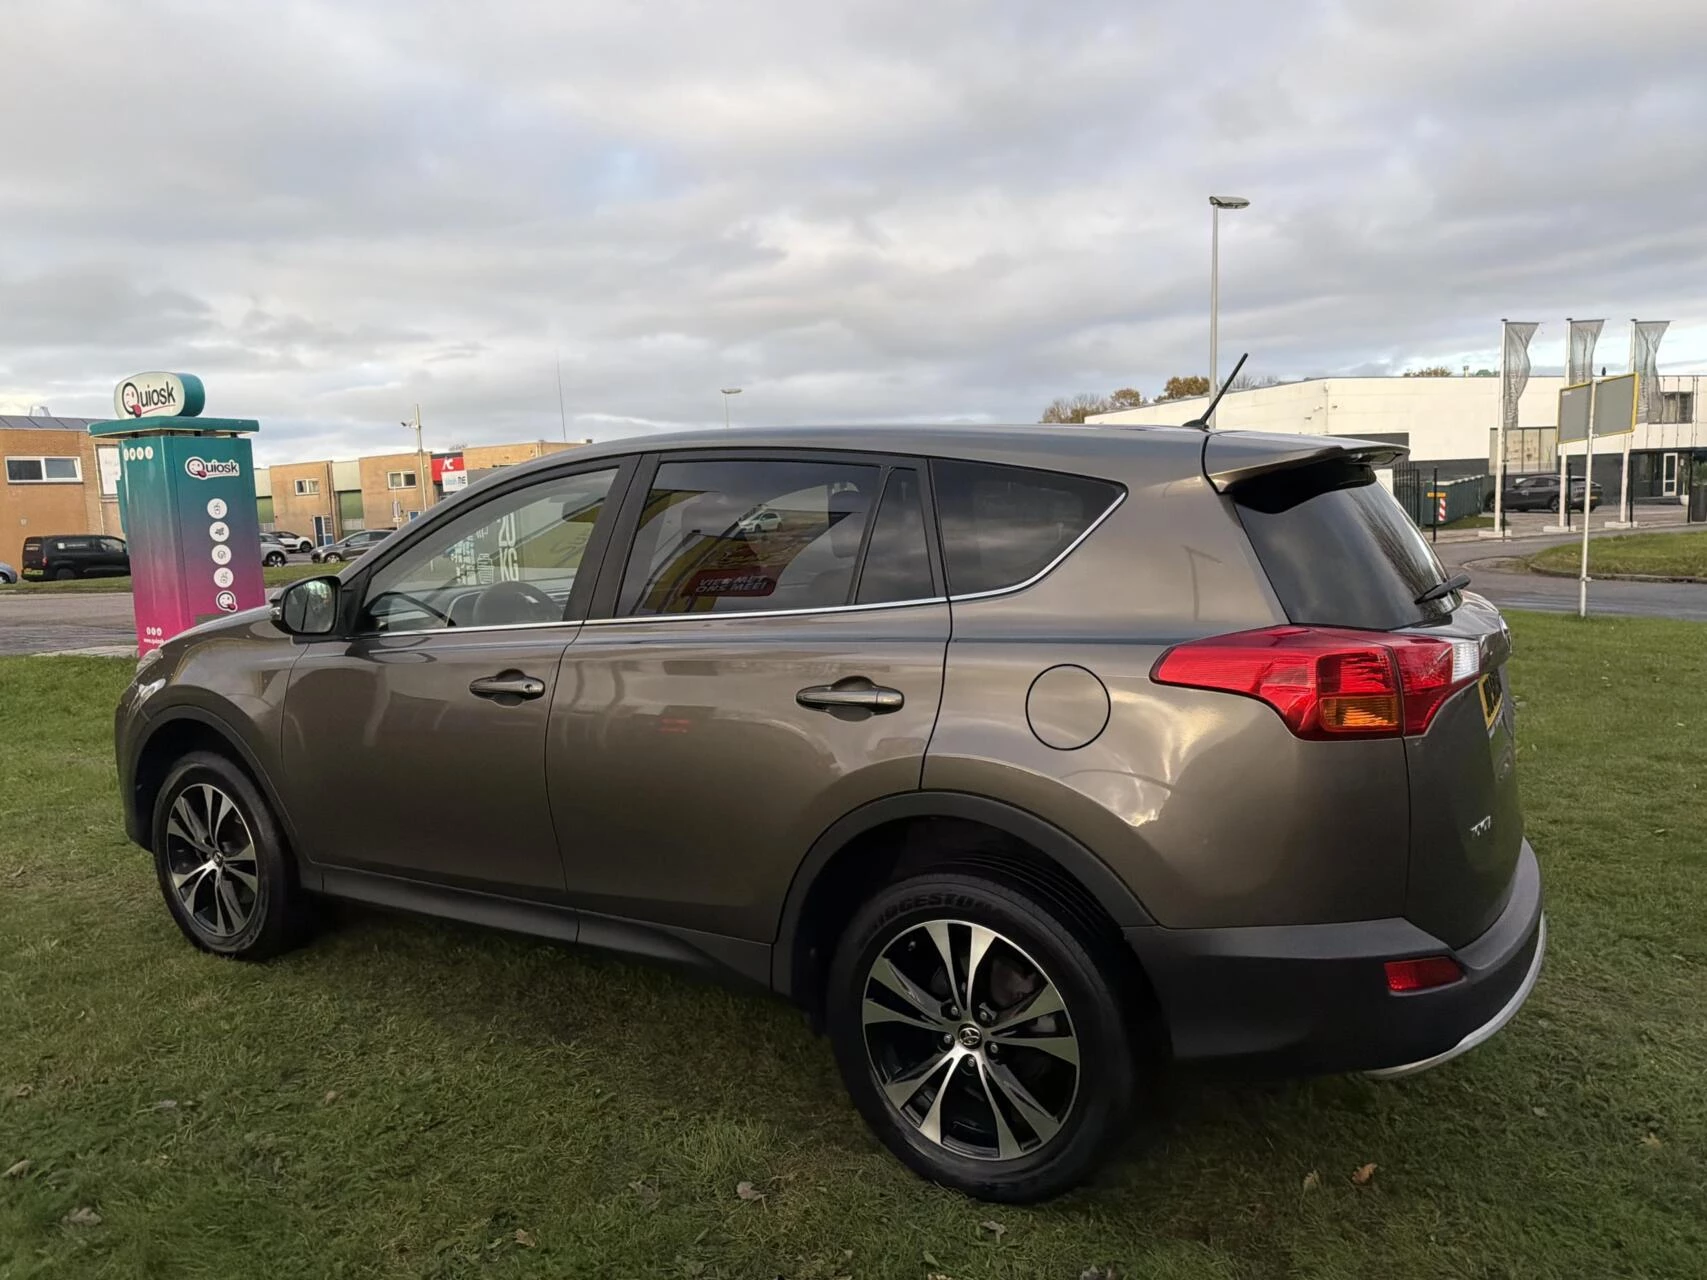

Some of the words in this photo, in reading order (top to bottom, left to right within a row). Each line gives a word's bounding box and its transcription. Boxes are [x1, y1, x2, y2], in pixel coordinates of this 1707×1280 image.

[122, 381, 176, 417] Quiosk
[187, 458, 239, 477] Quiosk
[499, 547, 519, 582] KG
